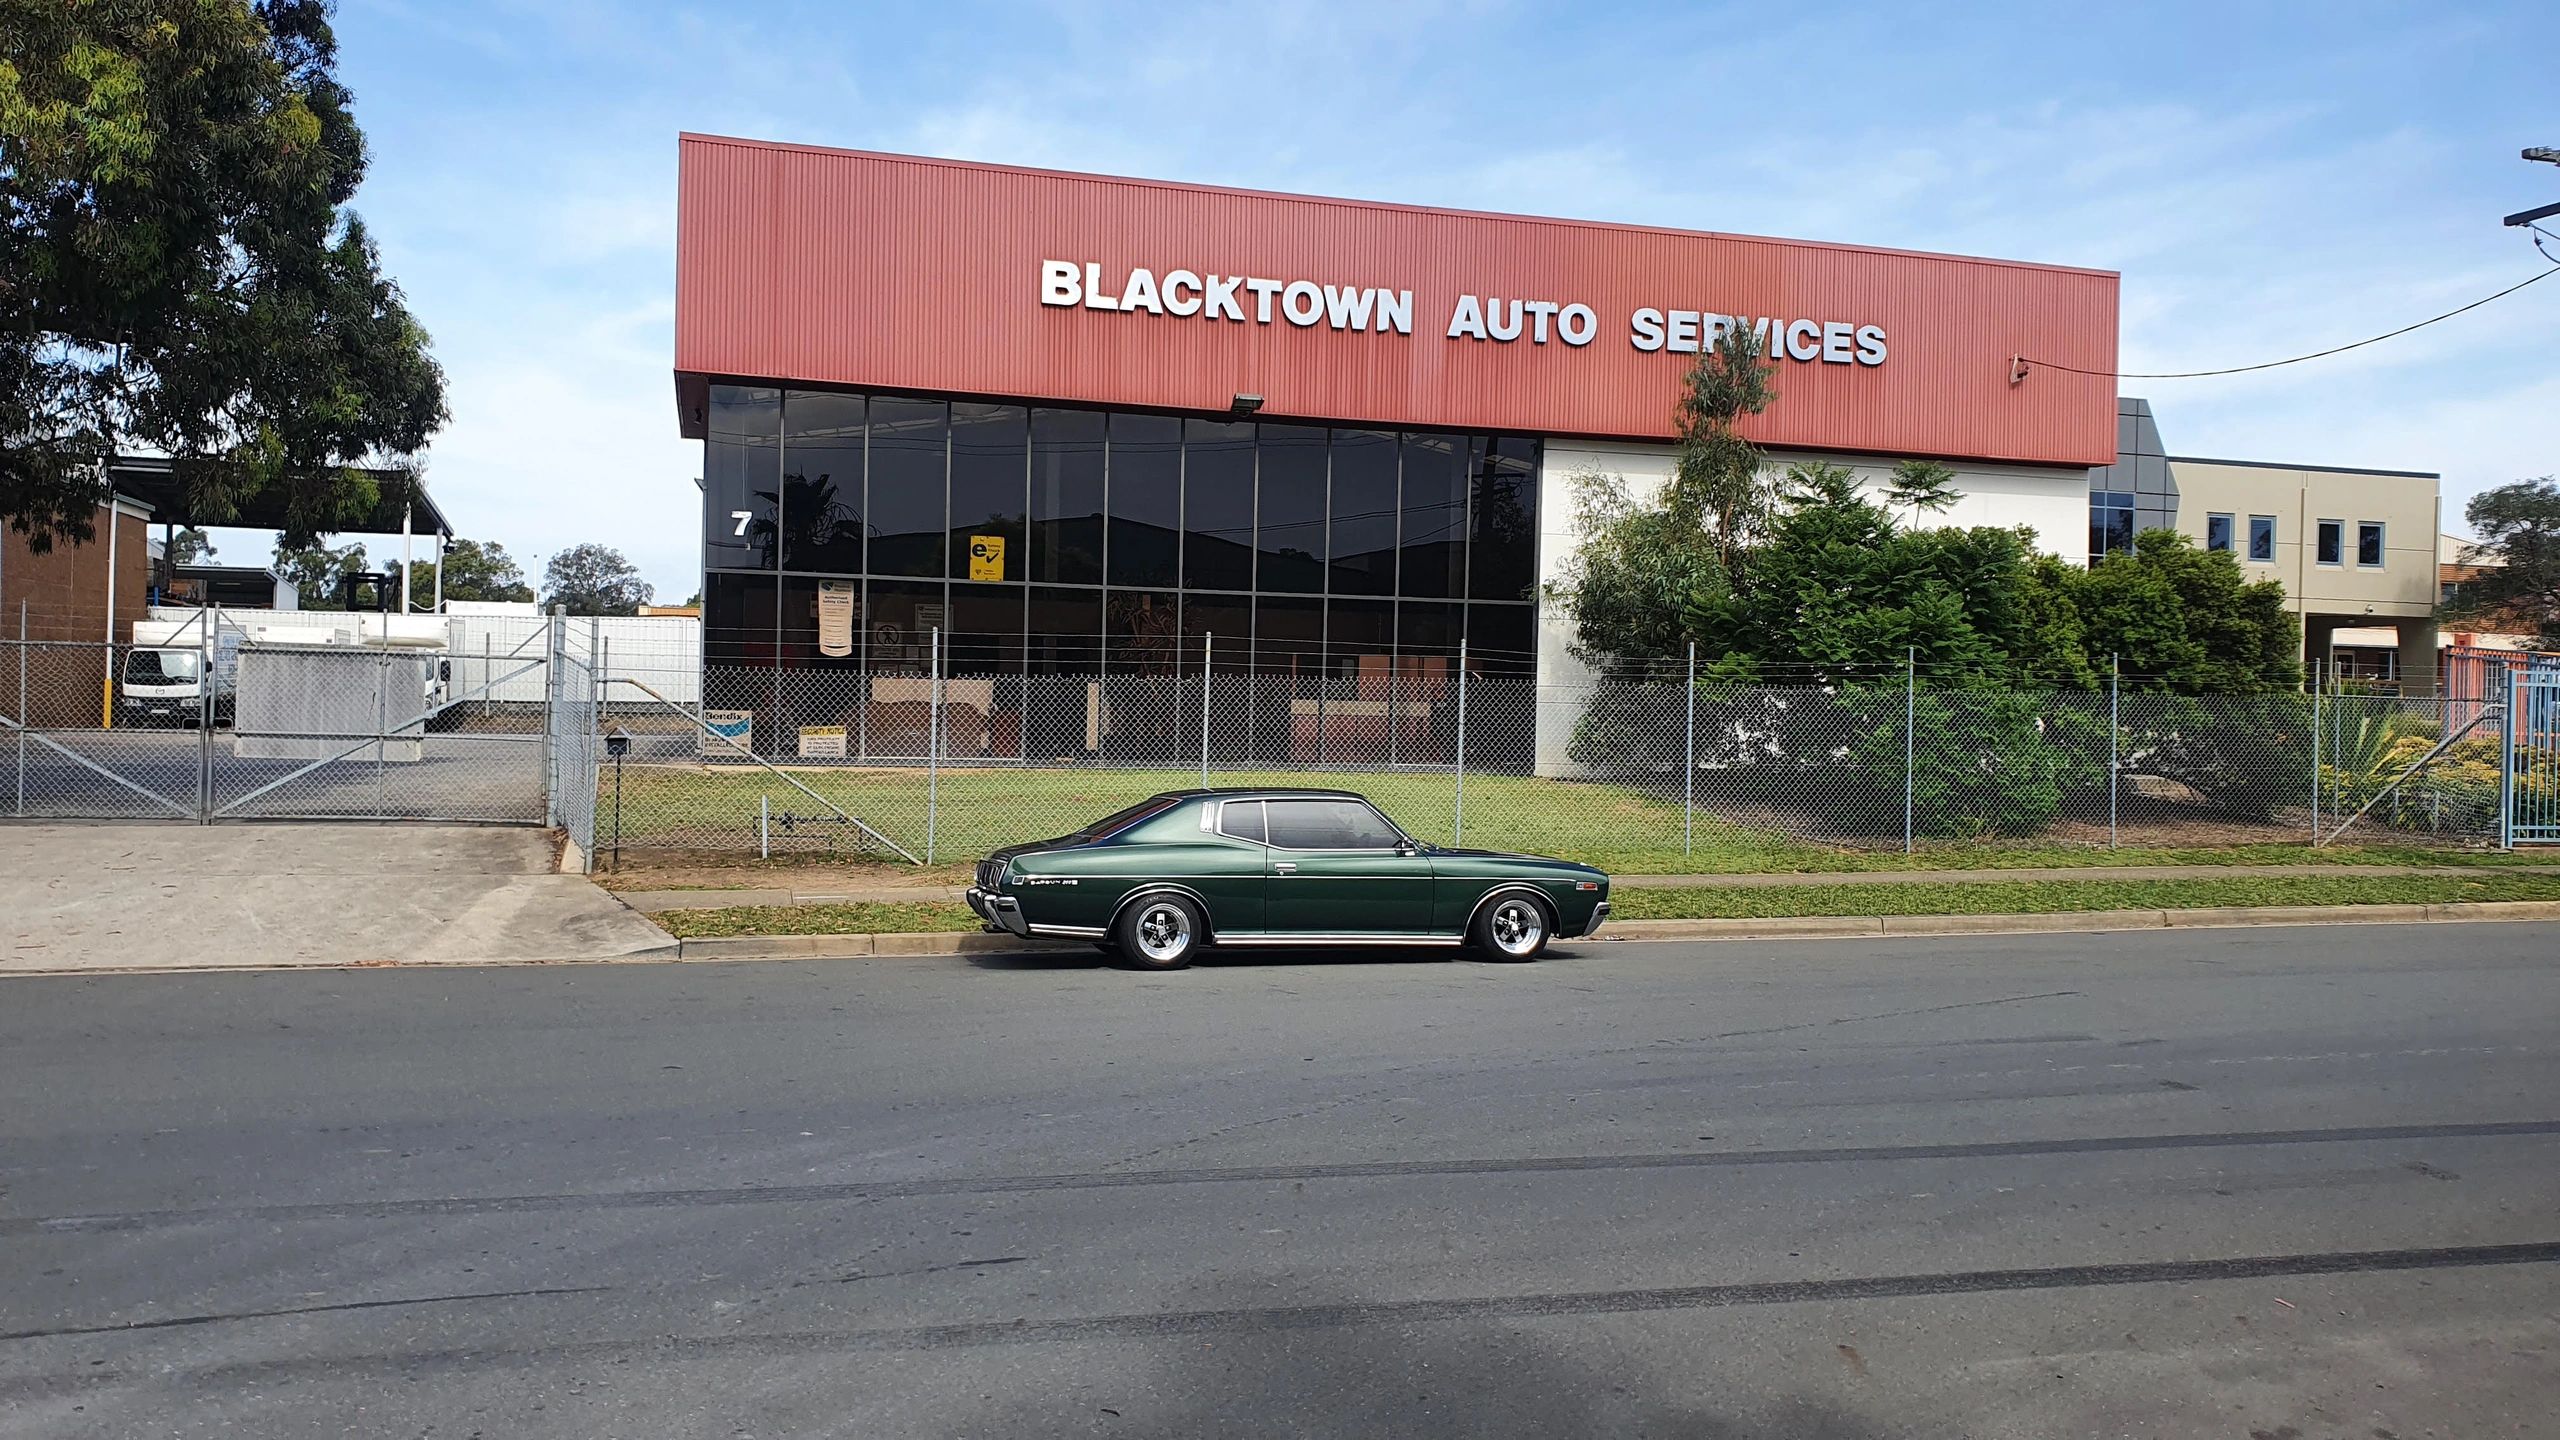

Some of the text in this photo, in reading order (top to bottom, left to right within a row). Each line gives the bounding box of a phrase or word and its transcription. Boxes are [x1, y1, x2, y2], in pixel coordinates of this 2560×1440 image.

[1041, 259, 1888, 366] BLACKTOWN AUTO SERVICES
[731, 510, 753, 536] 7
